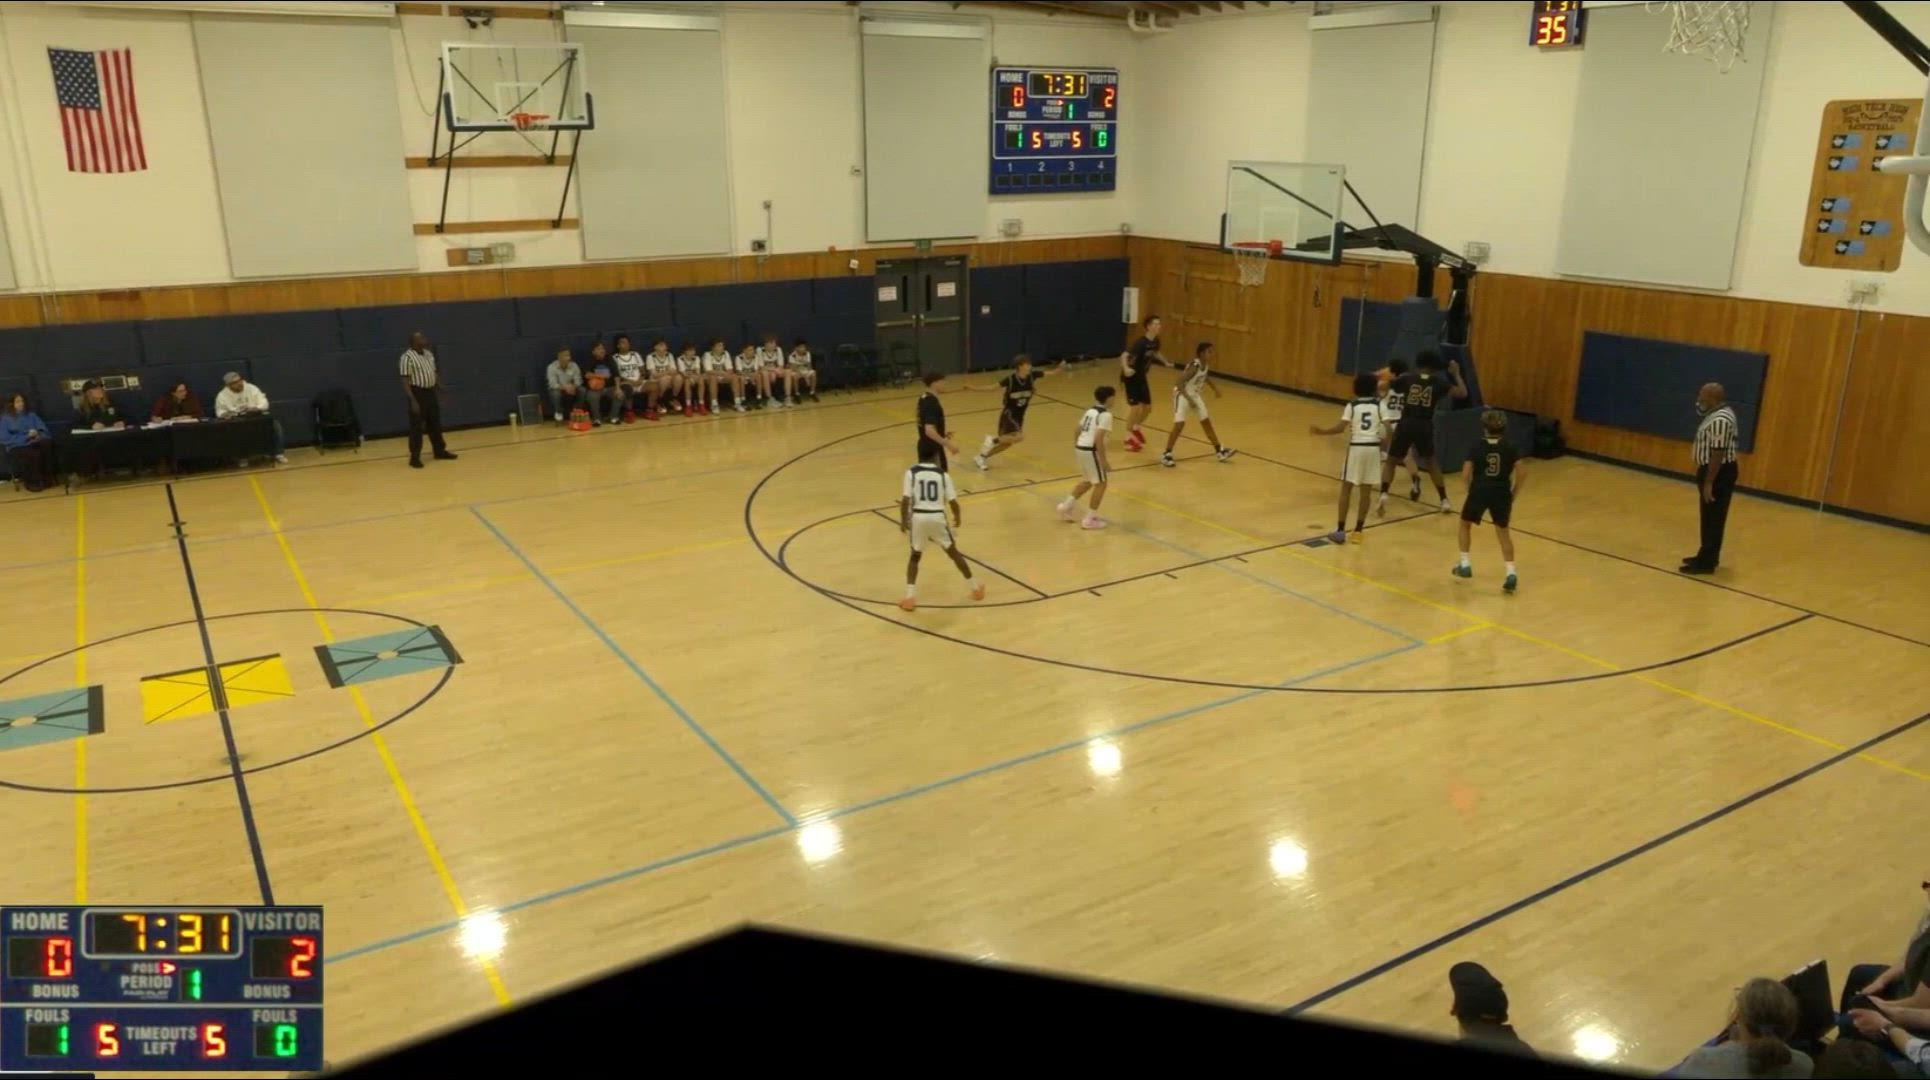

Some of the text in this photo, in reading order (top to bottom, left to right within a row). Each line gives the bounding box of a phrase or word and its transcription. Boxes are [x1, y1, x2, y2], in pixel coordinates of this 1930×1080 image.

[1537, 15, 1566, 44] 35
[1000, 72, 1024, 83] HOME
[1043, 74, 1085, 95] 7:31
[1013, 86, 1025, 107] 0
[1104, 87, 1115, 108] 2
[1068, 103, 1074, 119] 1
[1018, 132, 1022, 148] 1
[1032, 131, 1042, 149] 5
[1072, 131, 1082, 148] 5
[1098, 131, 1107, 147] 0
[1008, 160, 1105, 172] 1 2 3 4
[1408, 384, 1432, 407] 24
[1361, 412, 1372, 431] 5
[1485, 453, 1500, 476] 3
[919, 480, 938, 501] 10
